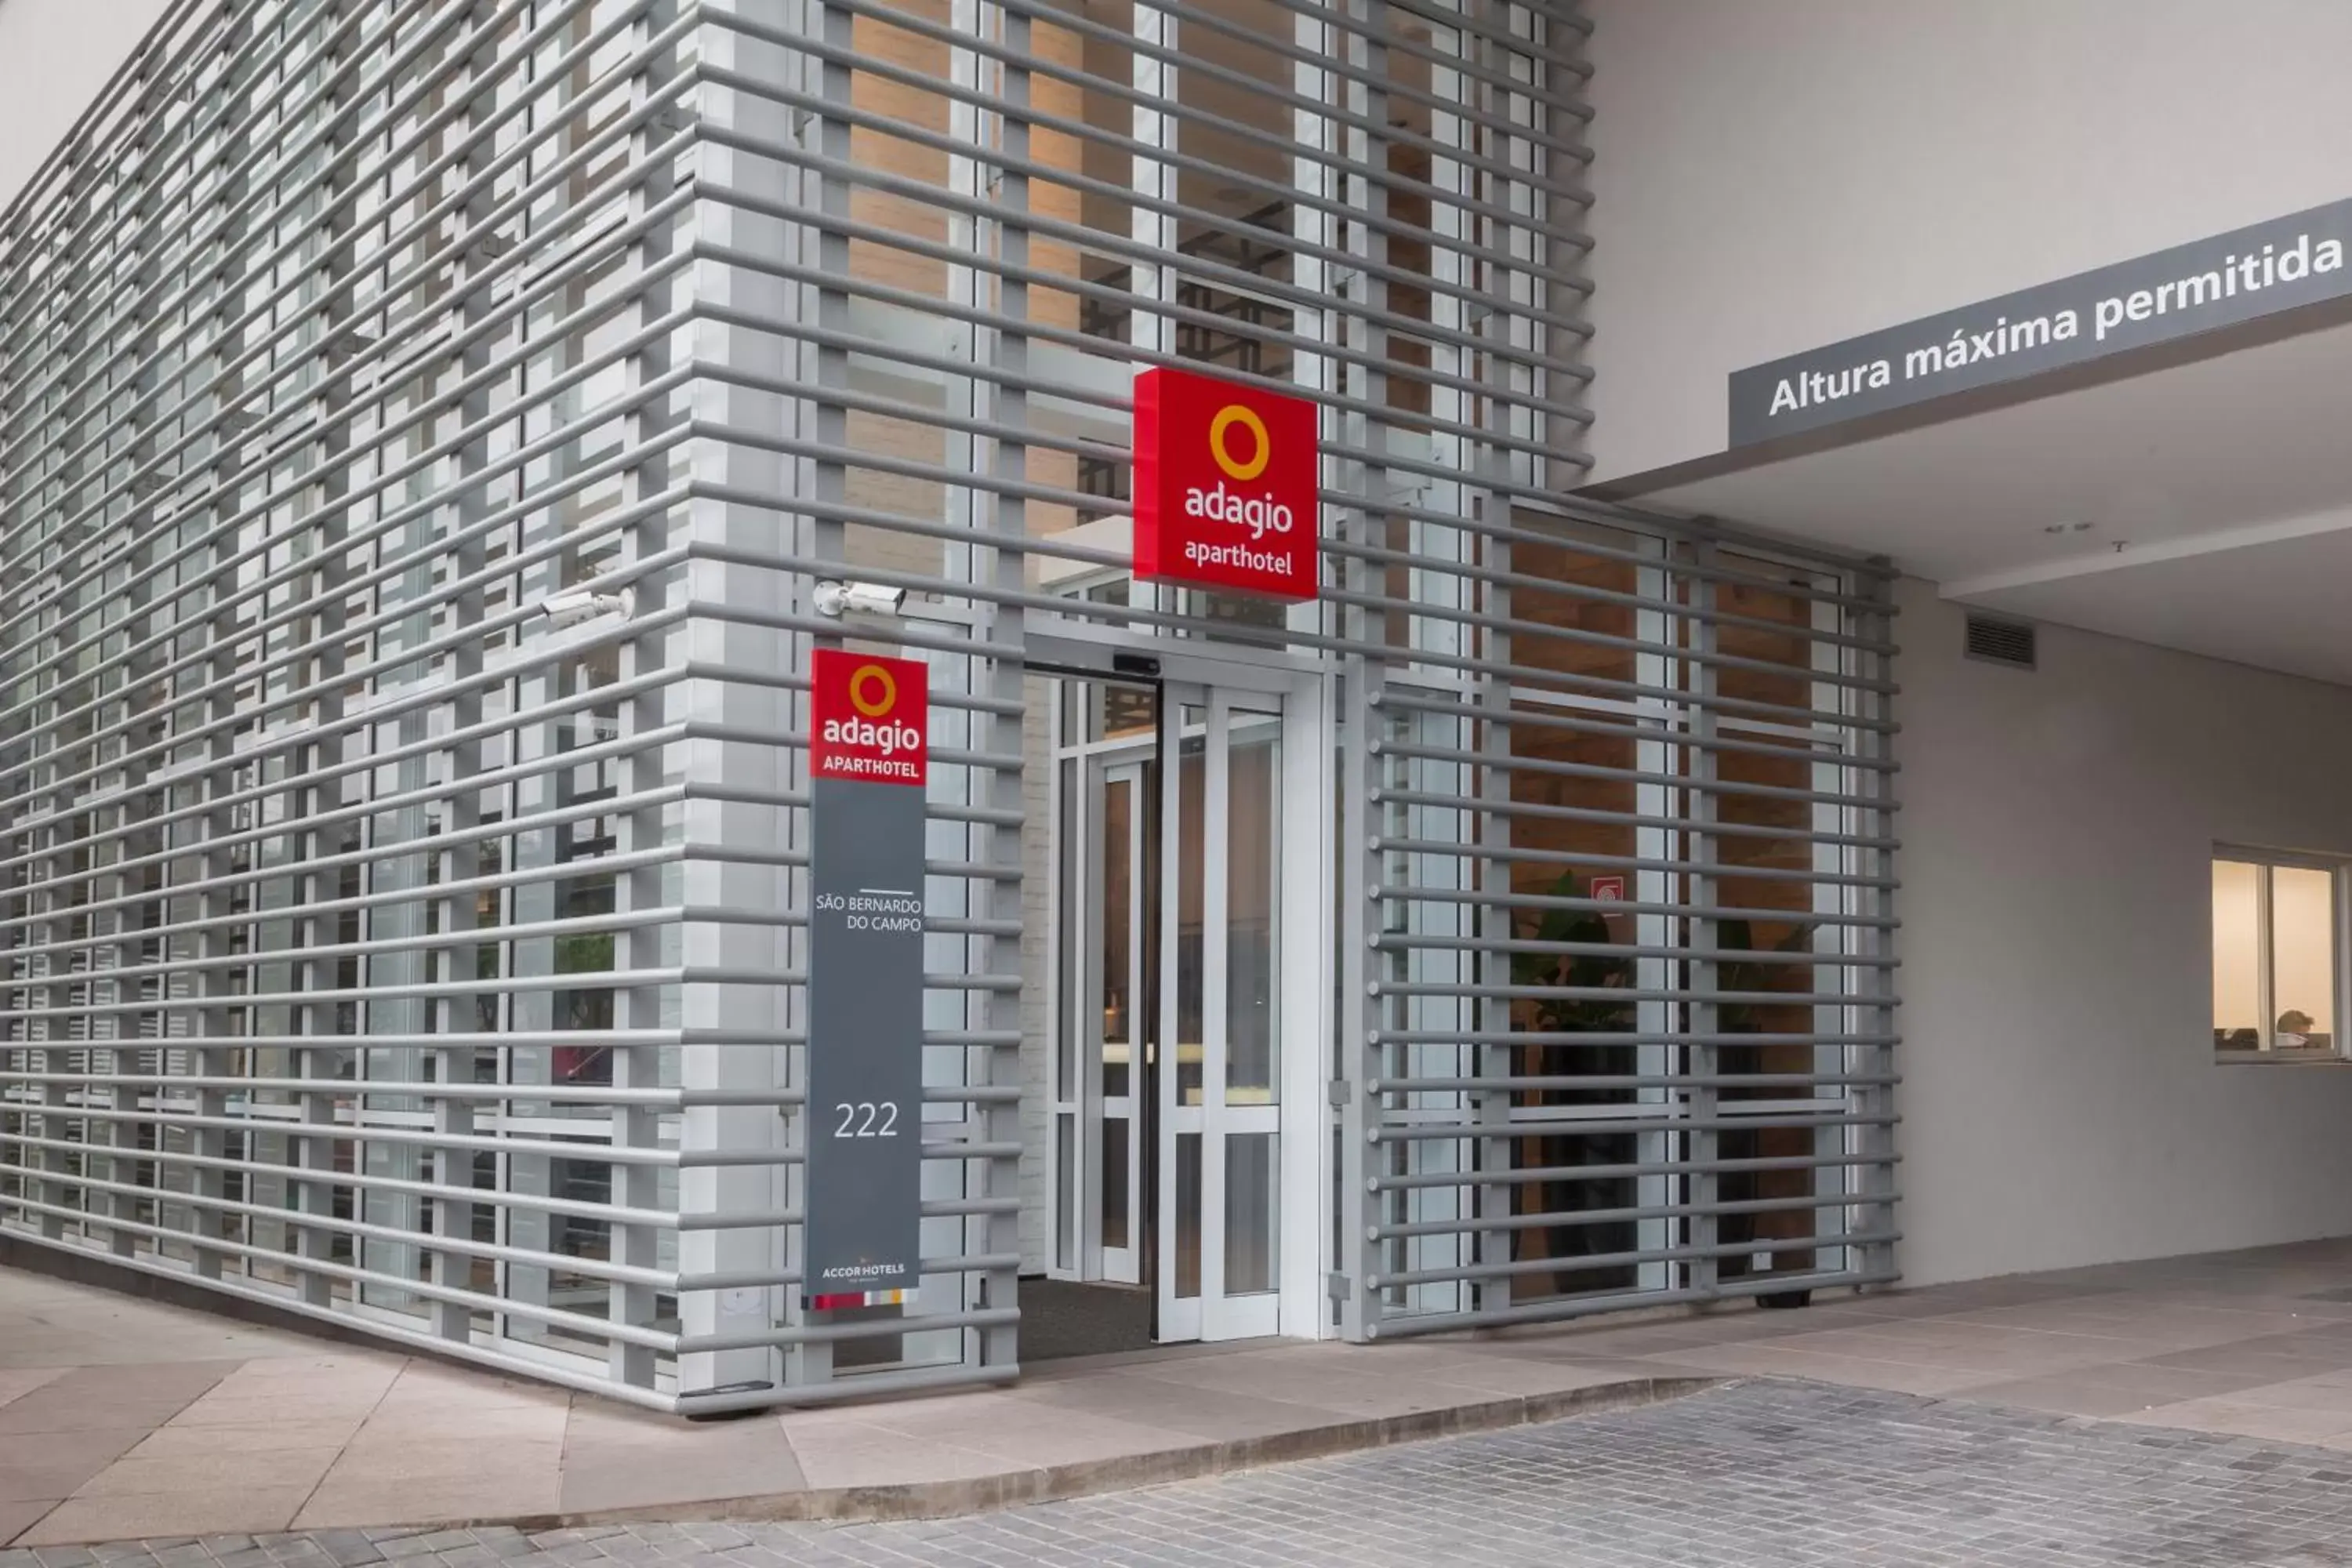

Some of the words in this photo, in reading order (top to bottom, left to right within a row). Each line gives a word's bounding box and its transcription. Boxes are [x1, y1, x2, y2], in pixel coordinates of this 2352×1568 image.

[1769, 359, 1891, 416] Altura
[1905, 308, 2078, 379] máxima
[2094, 234, 2342, 340] permitida
[1185, 481, 1293, 540] adagio
[1185, 541, 1293, 575] aparthotel
[823, 716, 920, 755] adagio
[823, 756, 920, 778] APARTHOTEL
[816, 894, 844, 910] SÃO
[848, 897, 921, 913] BERNARDO
[847, 915, 869, 930] DO
[871, 916, 921, 932] CAMPO
[834, 1102, 898, 1138] 222
